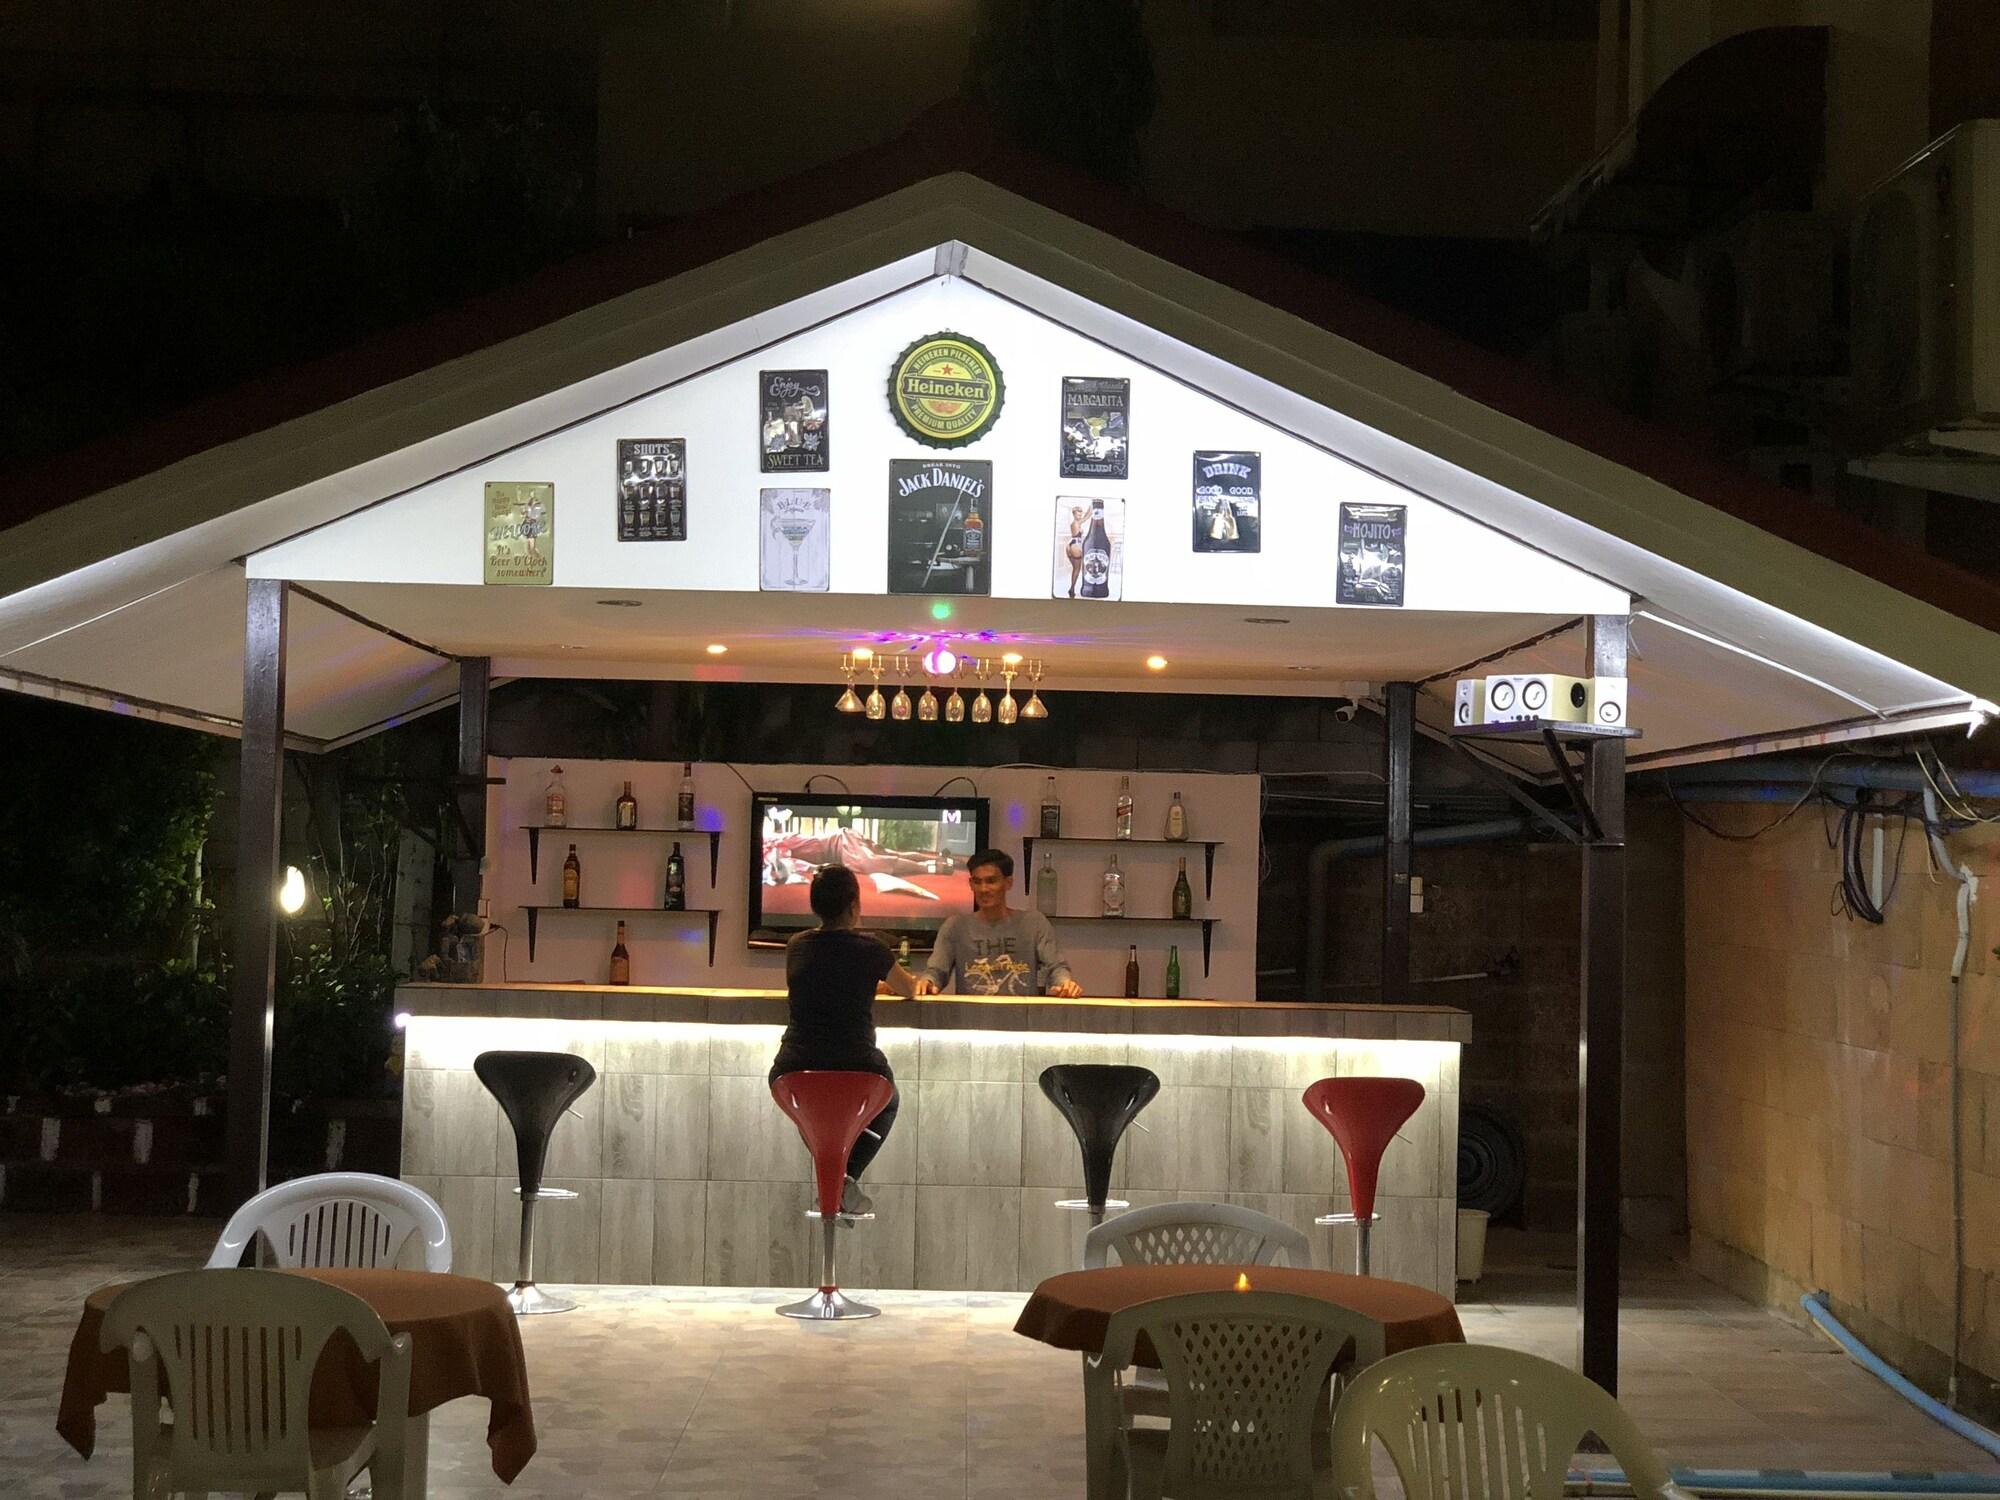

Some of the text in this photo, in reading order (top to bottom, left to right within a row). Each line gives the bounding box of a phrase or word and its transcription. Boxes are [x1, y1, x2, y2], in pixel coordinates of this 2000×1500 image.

[914, 349, 982, 375] HEINEKEN PILSENER
[770, 376, 820, 398] Enjoy
[907, 379, 984, 398] Heineken
[1067, 394, 1123, 407] MARGARITA
[911, 404, 978, 430] PREMIUM QUALITY
[633, 444, 670, 455] SHOTS
[767, 454, 823, 469] SWEET TEA
[1202, 463, 1251, 479] DRINK
[898, 468, 985, 498] JACK DANIEL'S
[1229, 487, 1254, 495] GOOD
[1352, 523, 1391, 539] MOJITO
[973, 938, 1016, 956] THE
